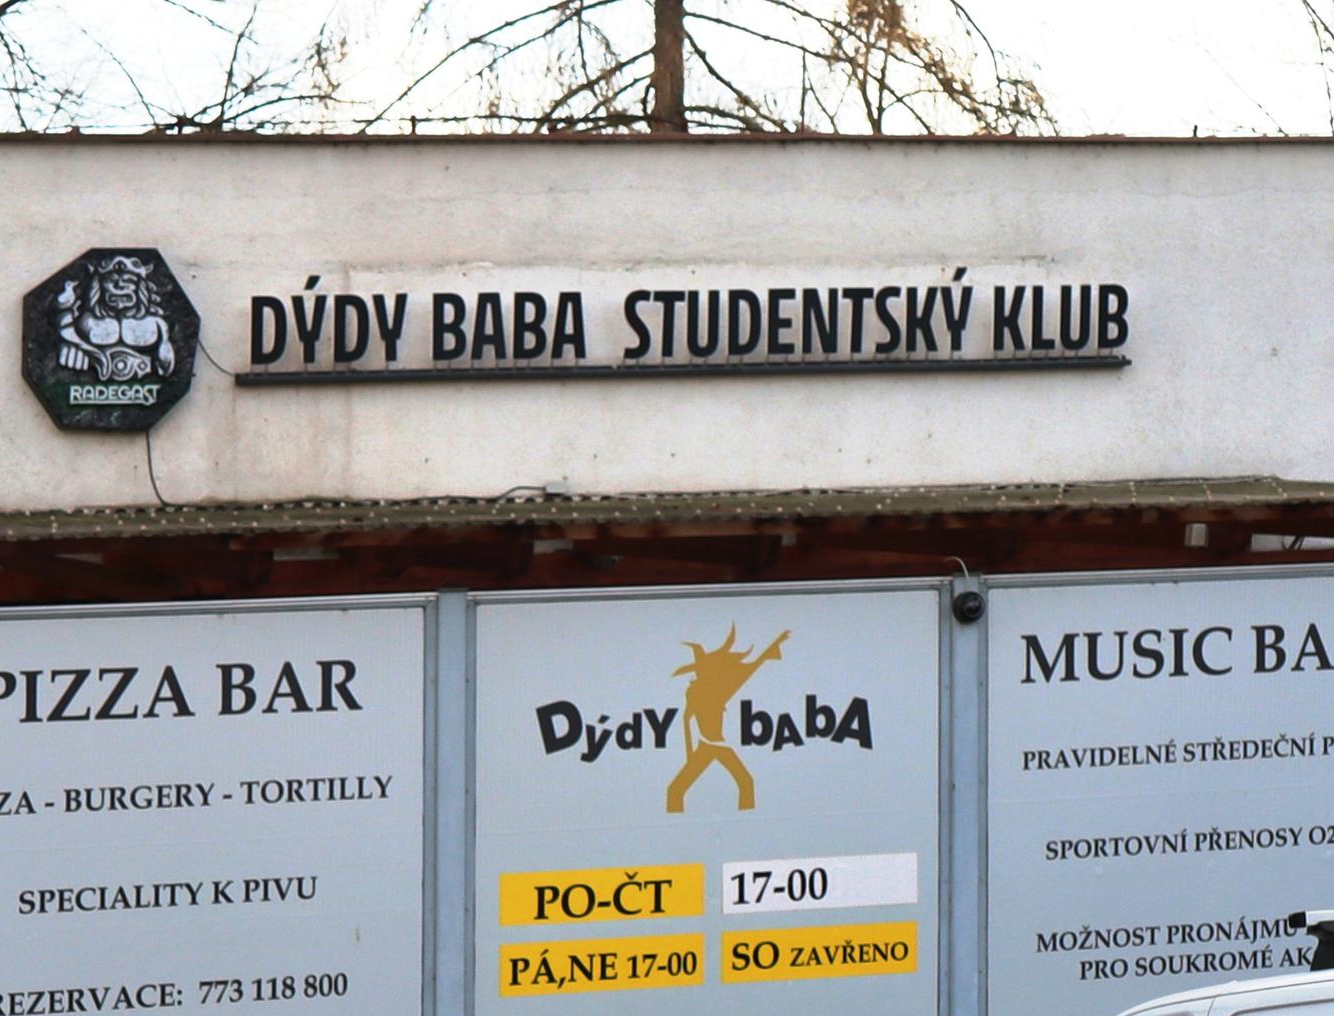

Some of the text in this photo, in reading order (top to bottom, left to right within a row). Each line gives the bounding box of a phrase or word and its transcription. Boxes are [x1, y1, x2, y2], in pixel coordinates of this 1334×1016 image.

[250, 267, 1130, 366] DÝDY BABA STUDENTSKÝ KLUB
[70, 384, 161, 404] RADEGAST
[1021, 627, 1232, 683] MUSIC
[216, 660, 362, 715] BAR
[1024, 740, 1176, 770] PRAVIDELNÉ
[1184, 733, 1315, 762] STŘEDEČNÍ
[64, 784, 214, 812] BURGERY
[240, 776, 392, 804] TORTILLY
[1046, 829, 1187, 860] SPORTOVNÍ
[1194, 825, 1302, 852] PŘENOSY
[19, 877, 316, 914] SPECIALITY K PIVU
[534, 872, 672, 920] PO-ČT
[731, 868, 827, 904] 17-00
[1037, 926, 1160, 952] MOŽNOST
[1167, 915, 1297, 946] PRONÁJMU
[510, 949, 697, 988] PÁ,NE 17-00
[732, 941, 908, 970] SO ZAVŘENO
[1081, 947, 1313, 980] PRO SOUKROMÉ AK
[200, 979, 243, 1004] 773
[252, 976, 295, 1001] 118
[304, 973, 347, 998] 800
